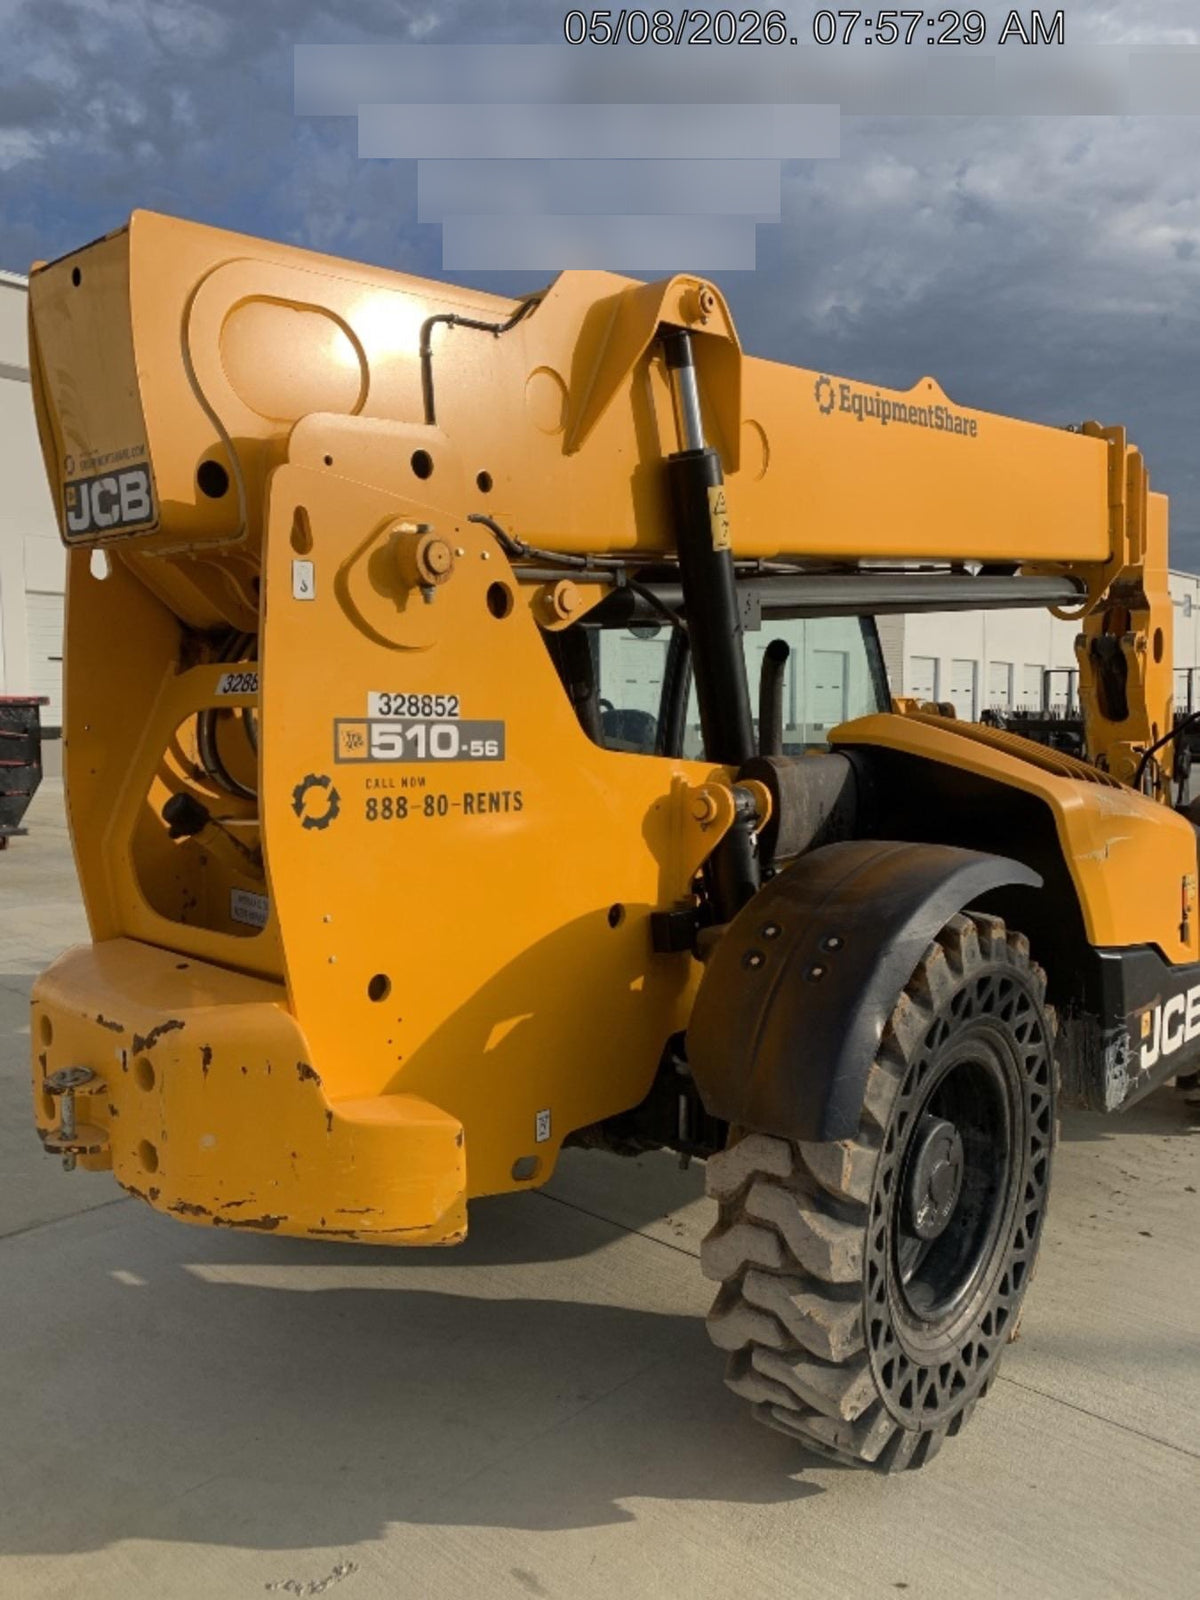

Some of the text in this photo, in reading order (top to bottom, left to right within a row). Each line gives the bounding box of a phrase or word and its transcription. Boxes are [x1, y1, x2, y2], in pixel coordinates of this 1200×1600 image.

[839, 384, 977, 438] EquipmentShare
[67, 471, 150, 530] JCB
[378, 693, 459, 717] 328852
[366, 777, 426, 789] CALL NOW
[366, 791, 523, 821] 888-80-RENTS
